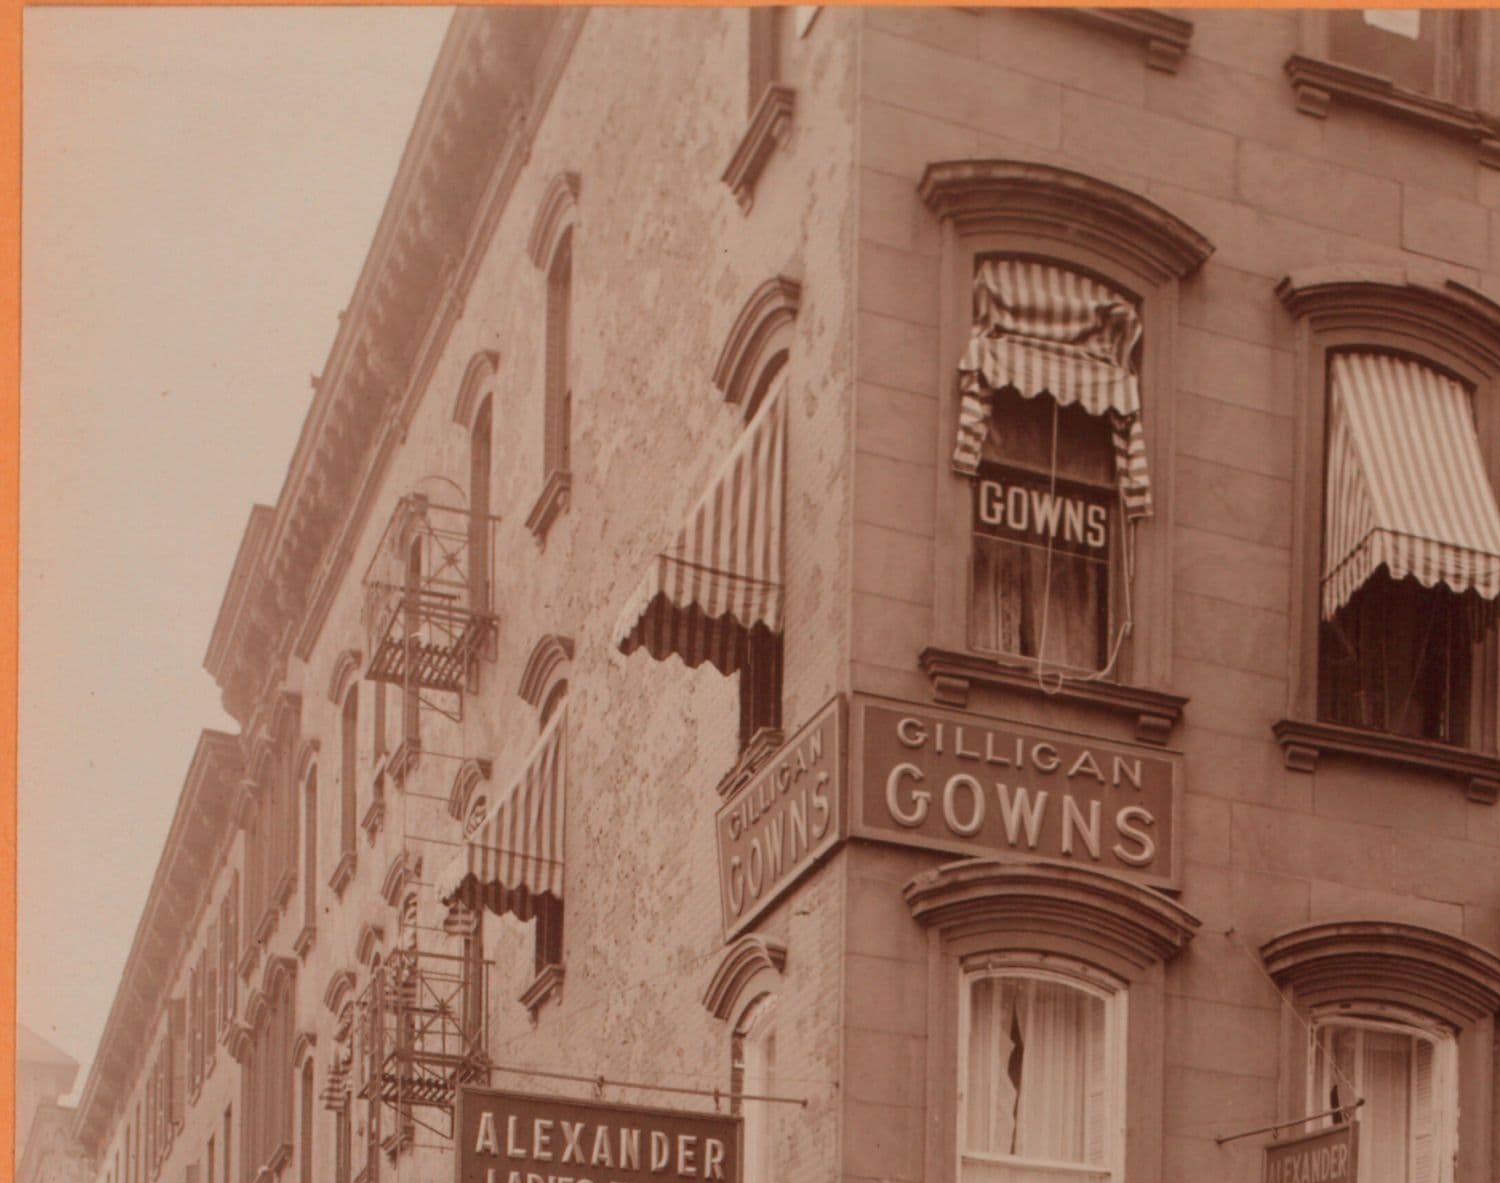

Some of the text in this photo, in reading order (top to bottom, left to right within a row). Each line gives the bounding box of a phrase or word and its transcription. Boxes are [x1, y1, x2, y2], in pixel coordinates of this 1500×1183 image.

[980, 480, 1107, 547] GOWNS
[730, 727, 822, 842] GILLIGAN
[897, 717, 1143, 789] GILLIGAN
[730, 771, 830, 917] GOWNS
[887, 763, 1156, 866] GOWNS
[476, 1111, 726, 1180] ALEXANDER
